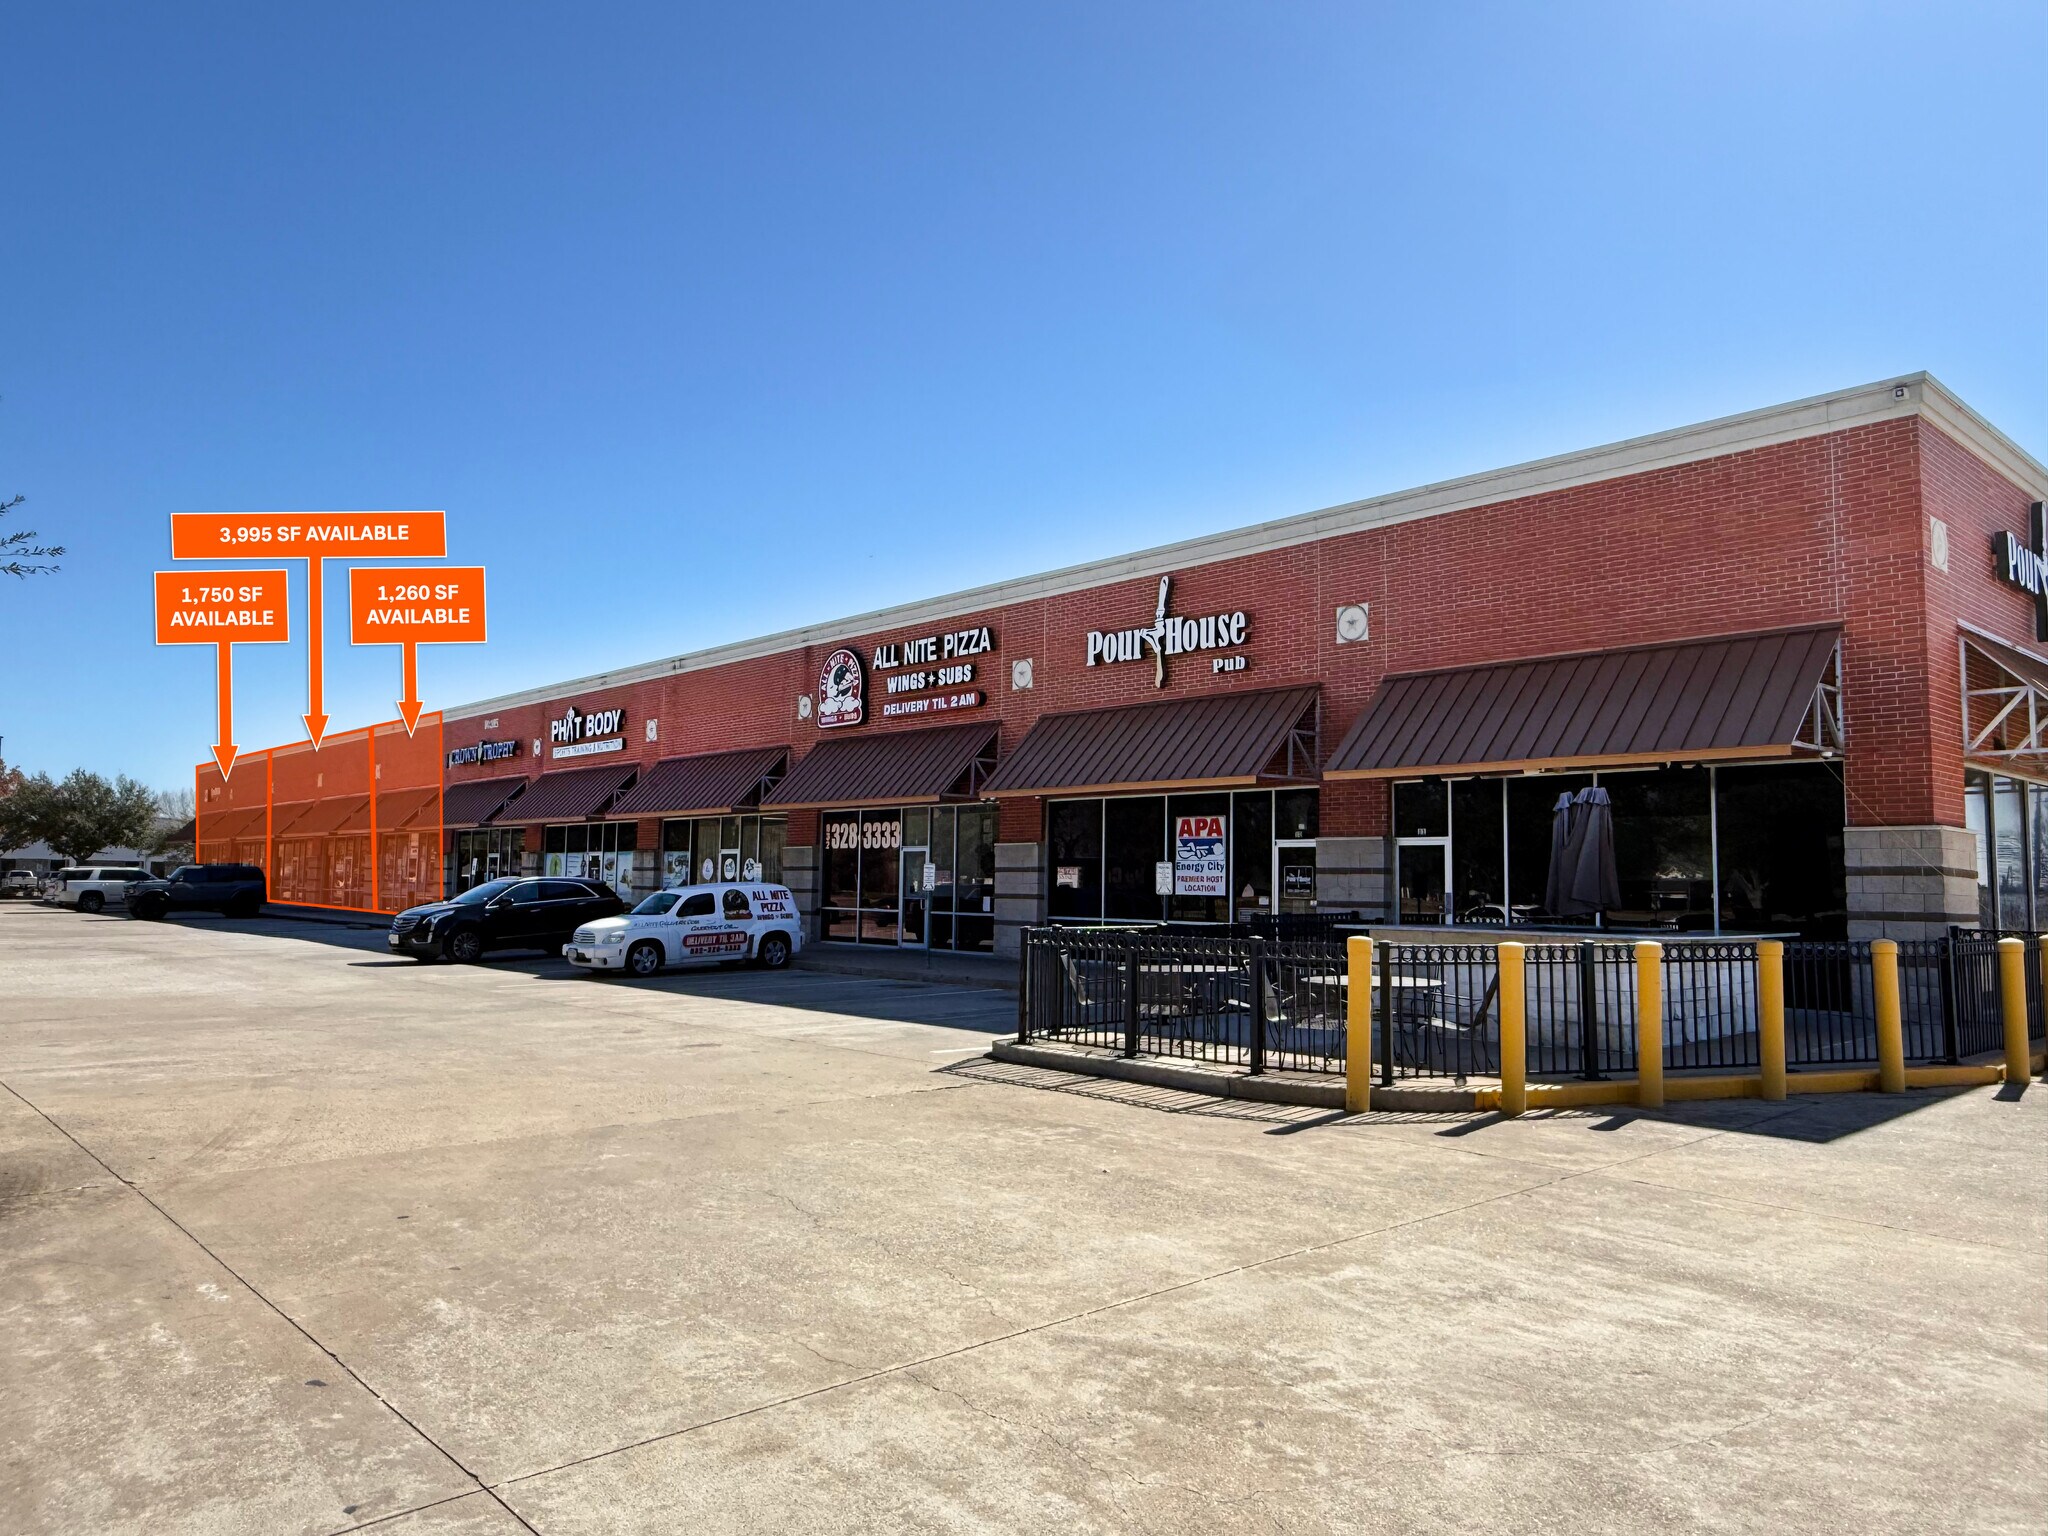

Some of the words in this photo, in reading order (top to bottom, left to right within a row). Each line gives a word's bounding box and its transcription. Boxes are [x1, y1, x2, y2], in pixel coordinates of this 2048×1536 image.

[872, 643, 899, 670] ALL
[903, 636, 938, 666] NITE
[943, 626, 991, 659] PIZZA
[1086, 628, 1143, 667] Pour
[1164, 611, 1246, 655] House
[829, 654, 845, 669] NITE
[1212, 655, 1246, 674] Pub
[887, 671, 926, 694] WINGS
[937, 664, 972, 686] SUBS
[883, 698, 929, 716] DELIVERY
[932, 697, 948, 710] TIL
[585, 709, 622, 737] BODY
[482, 741, 516, 761] TROPHY
[1178, 817, 1223, 838] APA
[1176, 861, 1205, 873] Energy
[1207, 861, 1225, 873] City
[1184, 884, 1216, 892] LOCATION
[1206, 875, 1223, 883] HOST
[752, 890, 769, 901] ALL
[770, 890, 790, 900] NITE
[760, 902, 786, 912] PIZZA
